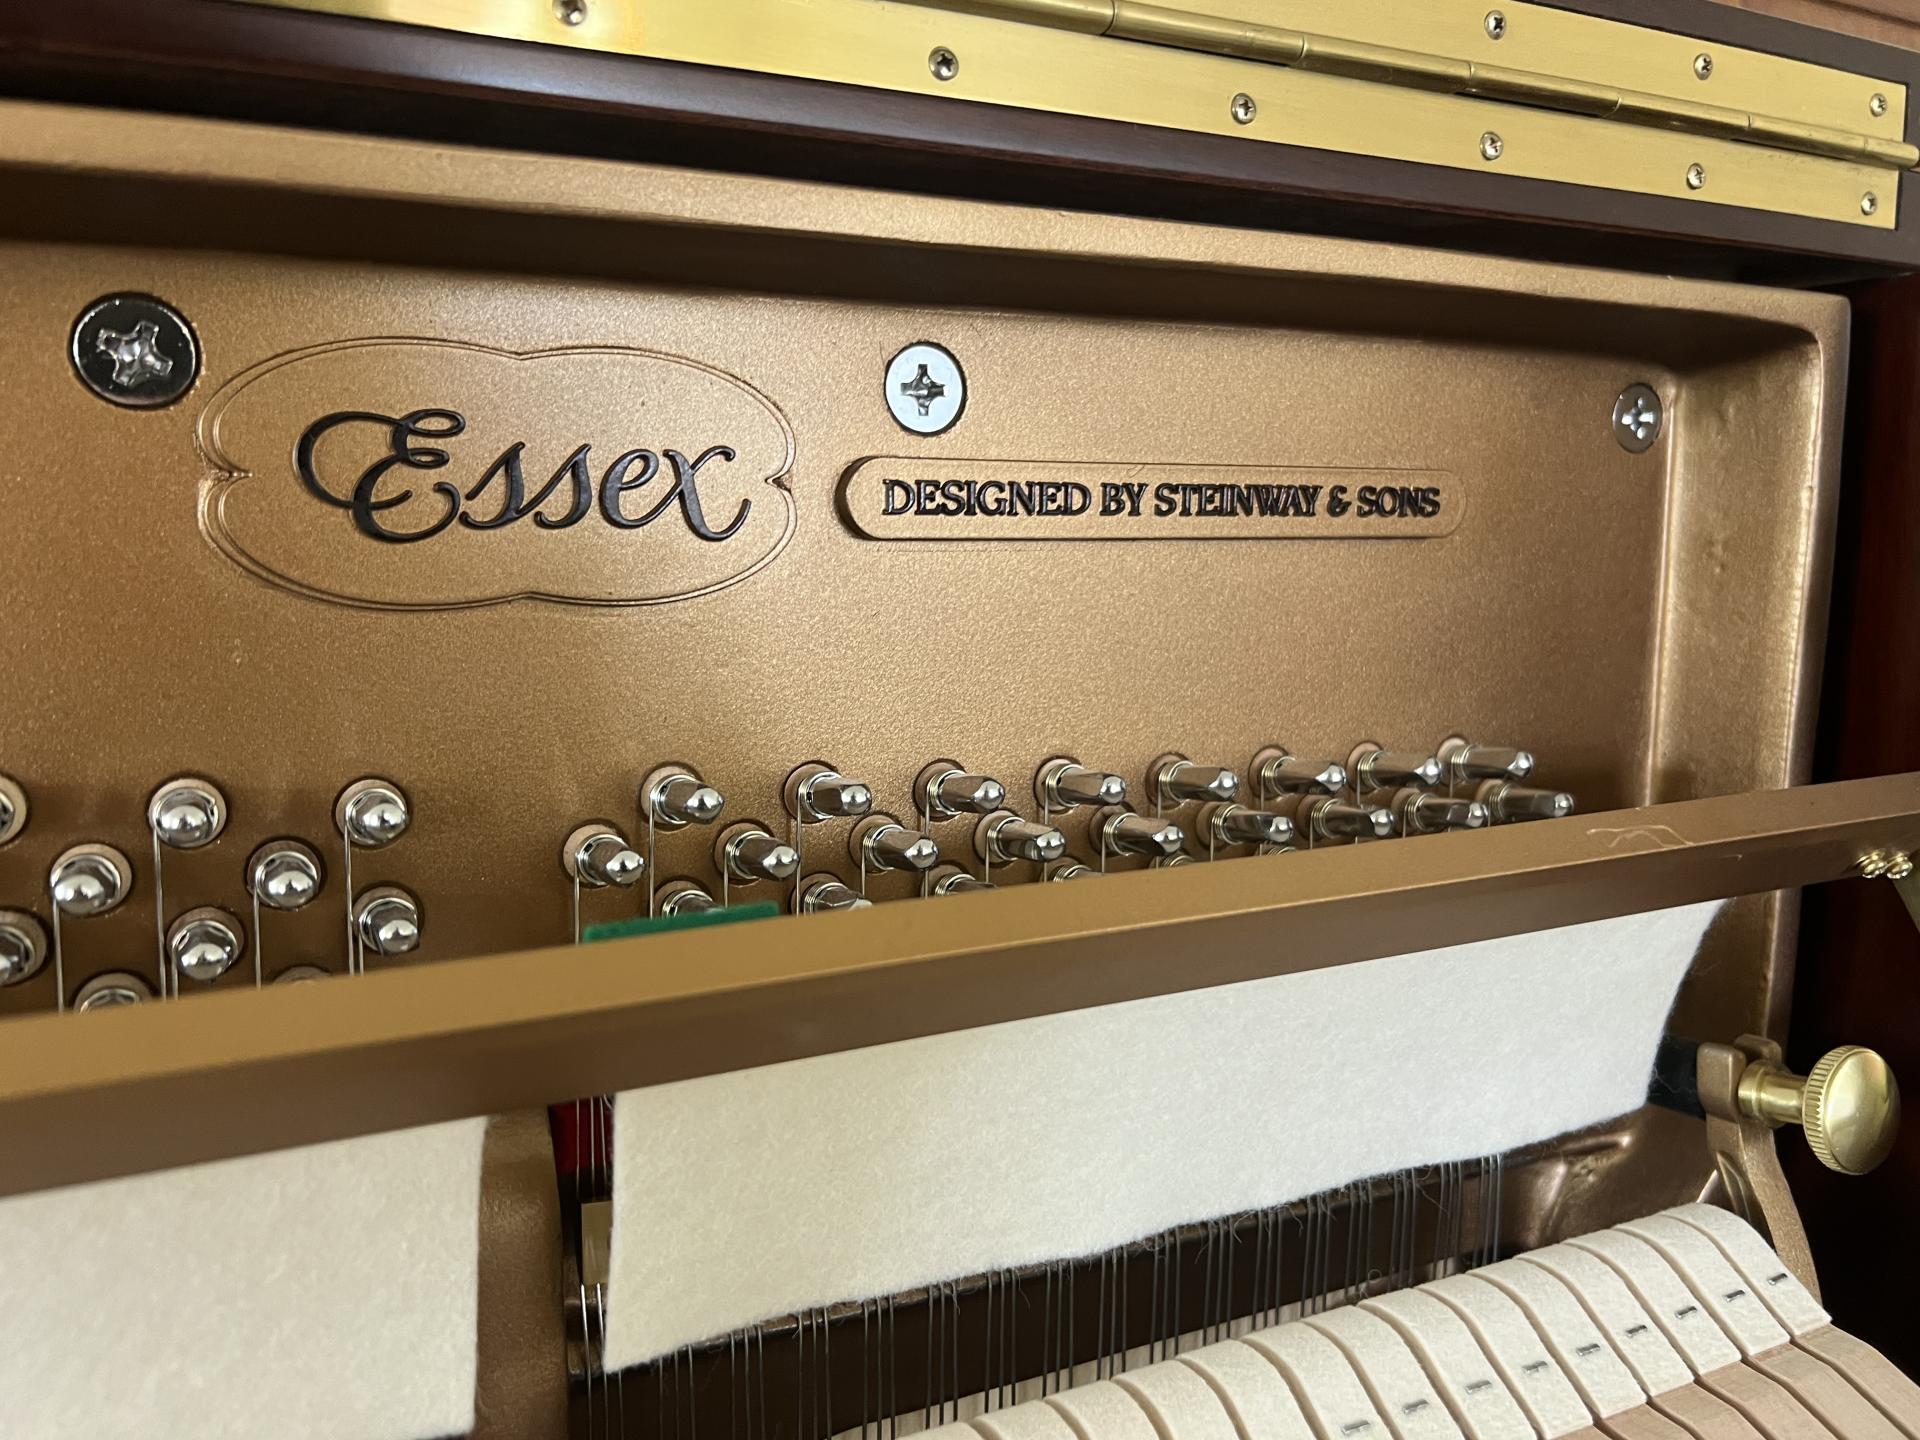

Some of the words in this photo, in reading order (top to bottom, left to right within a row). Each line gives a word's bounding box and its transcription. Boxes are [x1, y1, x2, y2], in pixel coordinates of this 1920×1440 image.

[296, 407, 752, 543] Essex
[882, 479, 1092, 516] DESIGNED
[1100, 482, 1148, 516] BY
[1153, 483, 1323, 517] STEINWAY
[1327, 486, 1351, 518] &
[1356, 486, 1441, 518] SONS
